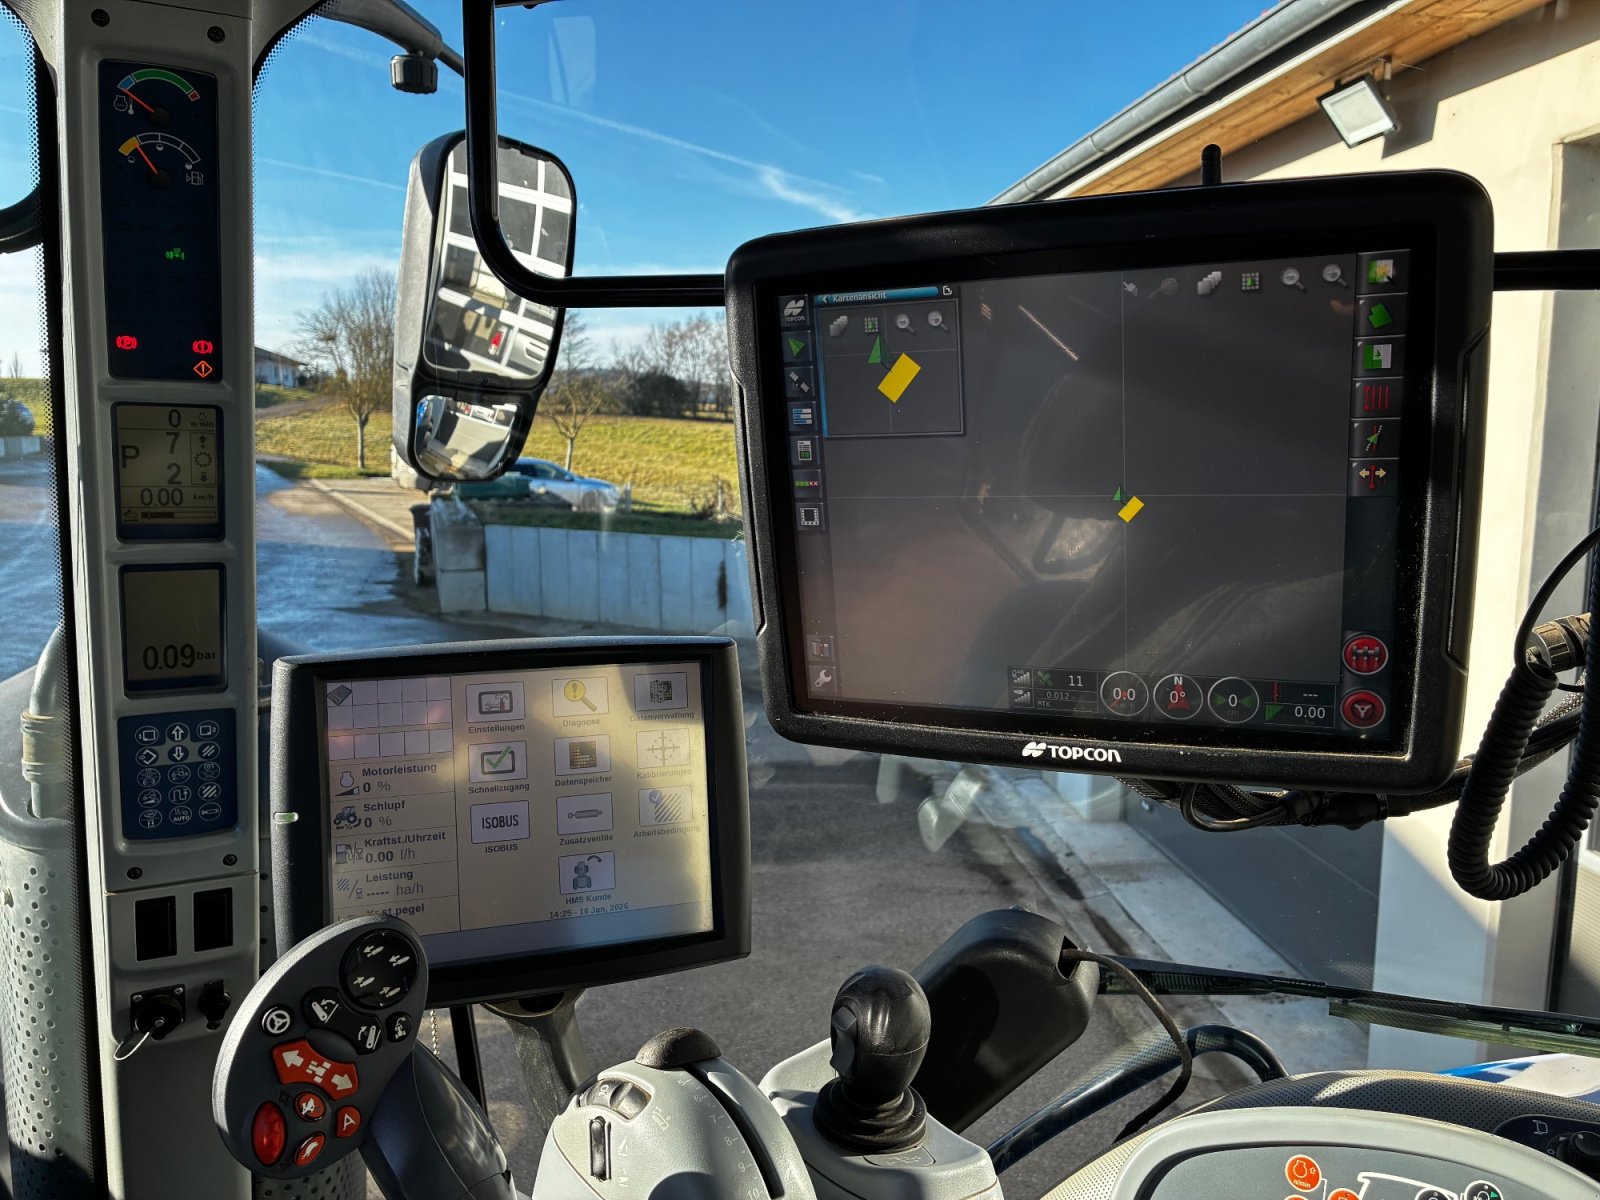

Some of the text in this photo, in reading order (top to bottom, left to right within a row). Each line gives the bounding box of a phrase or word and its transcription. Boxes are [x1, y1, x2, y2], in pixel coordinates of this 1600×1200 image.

[833, 292, 887, 303] Kartenansicht
[168, 408, 181, 428] 0
[165, 431, 180, 455] 7
[121, 444, 140, 469] P
[167, 462, 182, 485] 2
[140, 487, 184, 507] 0.00
[142, 643, 217, 672] 0.09 bar
[1068, 675, 1084, 687] 11
[1173, 676, 1183, 685] N
[1113, 687, 1136, 701] 0.0
[1228, 694, 1238, 707] 0
[1294, 705, 1326, 719] 0.00
[468, 723, 525, 734] Einstellungen
[562, 718, 601, 728] Diagnose
[1047, 745, 1122, 763] TOPCON
[361, 764, 437, 777] Motorleistung
[378, 781, 391, 792] %
[554, 775, 613, 787] Datenspeicher
[468, 783, 530, 795] Schnellzugang
[363, 800, 406, 812] Schlupf
[379, 816, 392, 827] %
[481, 814, 519, 829] ISOBUS
[364, 831, 447, 848] Kraftst./Uhrzeit
[559, 833, 614, 846] Zusatzventile
[485, 843, 519, 854] ISOBUS
[365, 850, 394, 864] 0.00
[365, 870, 414, 883] Leistung
[396, 882, 424, 897] ha/h
[565, 892, 612, 905] HMS Kunde
[549, 909, 573, 919] 14:25
[580, 907, 590, 915] 16
[609, 903, 629, 912] 2026
[723, 1136, 733, 1146] 8
[737, 1162, 746, 1173] 9
